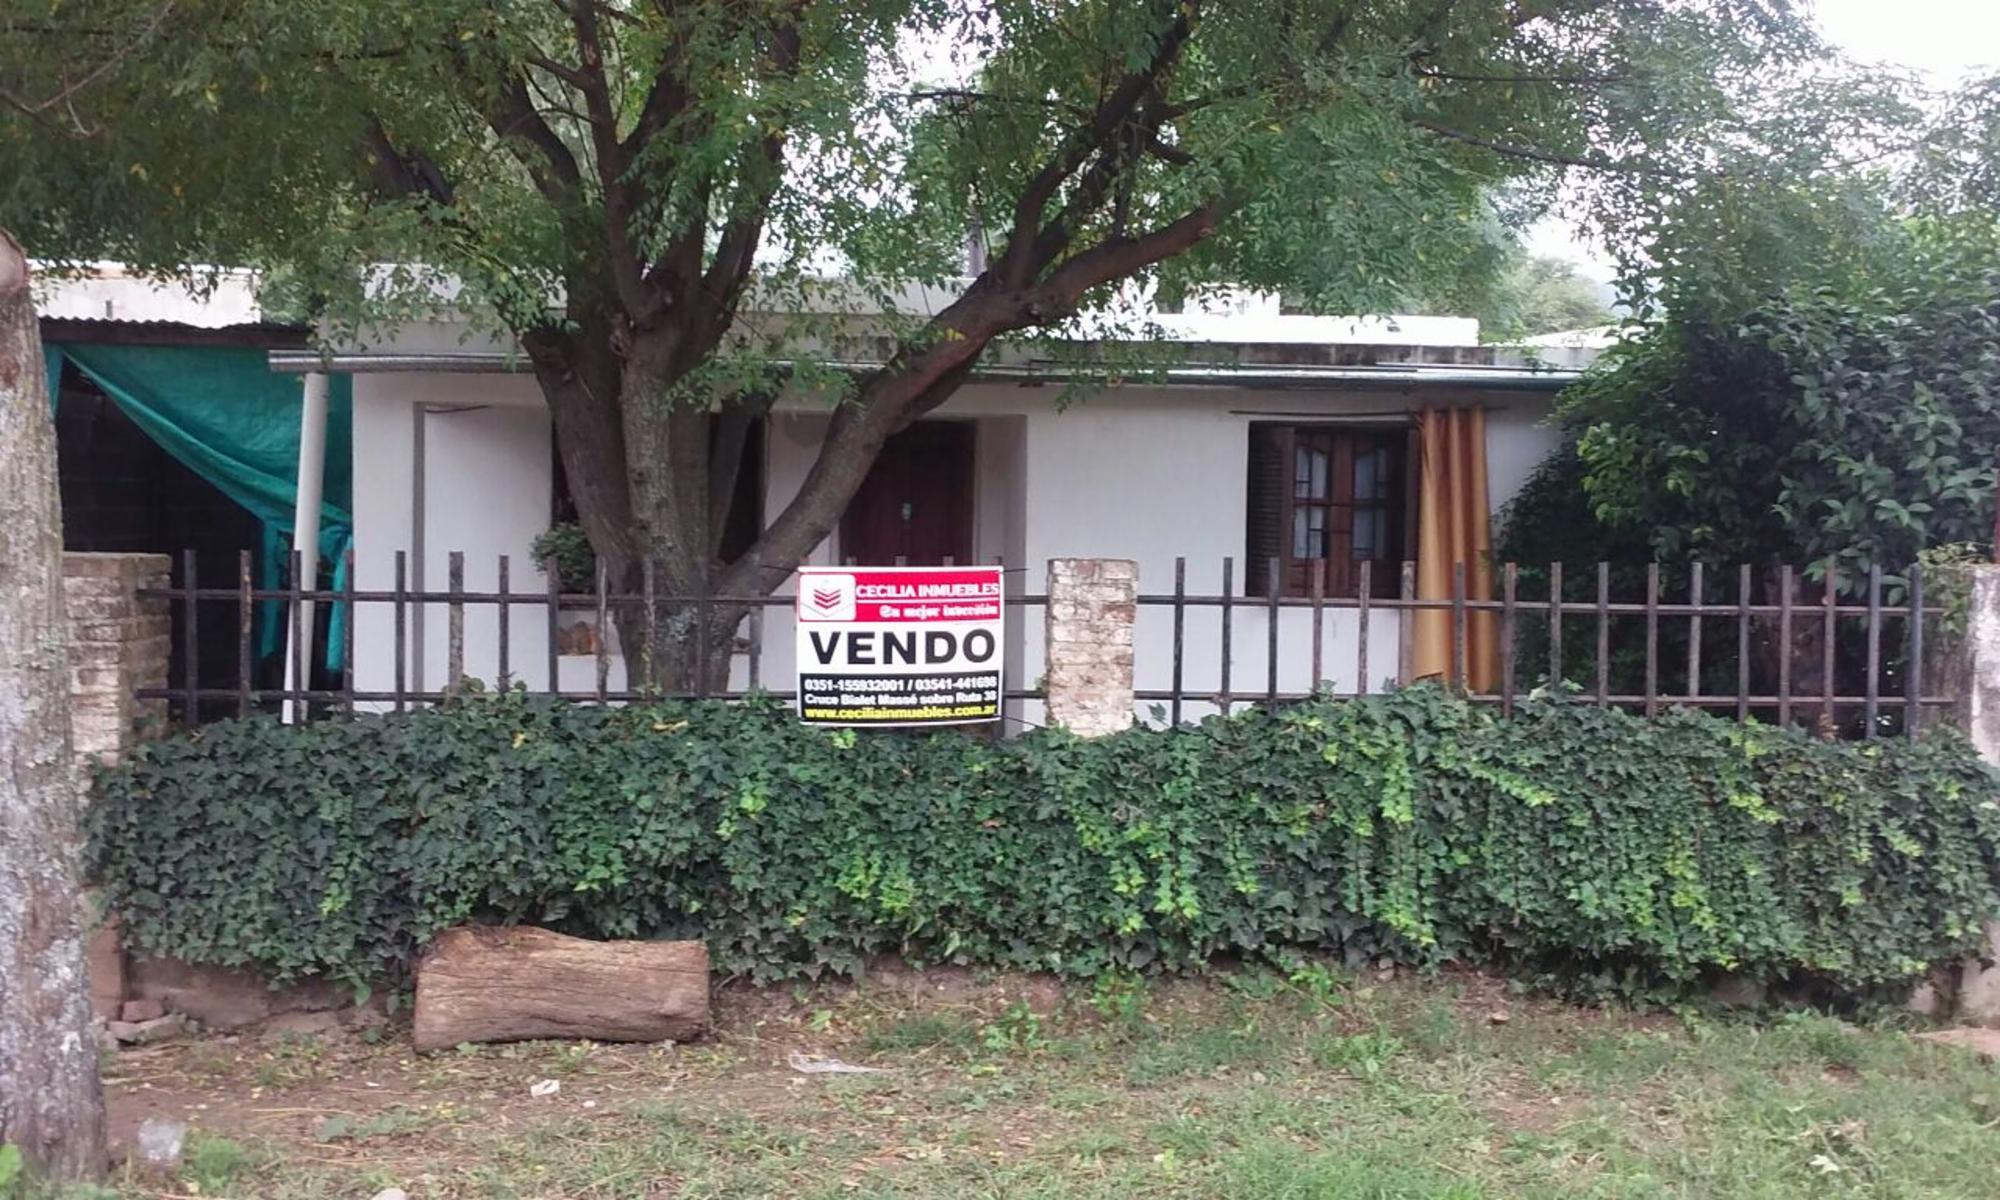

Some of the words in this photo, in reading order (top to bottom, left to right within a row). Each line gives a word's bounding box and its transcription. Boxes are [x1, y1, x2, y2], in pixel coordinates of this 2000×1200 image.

[856, 584, 915, 598] CECILIA
[918, 583, 1000, 598] INMUEBLES
[903, 604, 940, 620] mejor
[809, 628, 996, 665] VENDO
[907, 678, 913, 692] /
[804, 693, 839, 705] Cruce
[841, 694, 876, 706] Bialet
[878, 693, 918, 706] Massé
[920, 692, 954, 704] sobre
[956, 691, 982, 703] Ruta
[804, 704, 997, 720] www.ceciliainmuebles.com.ar
